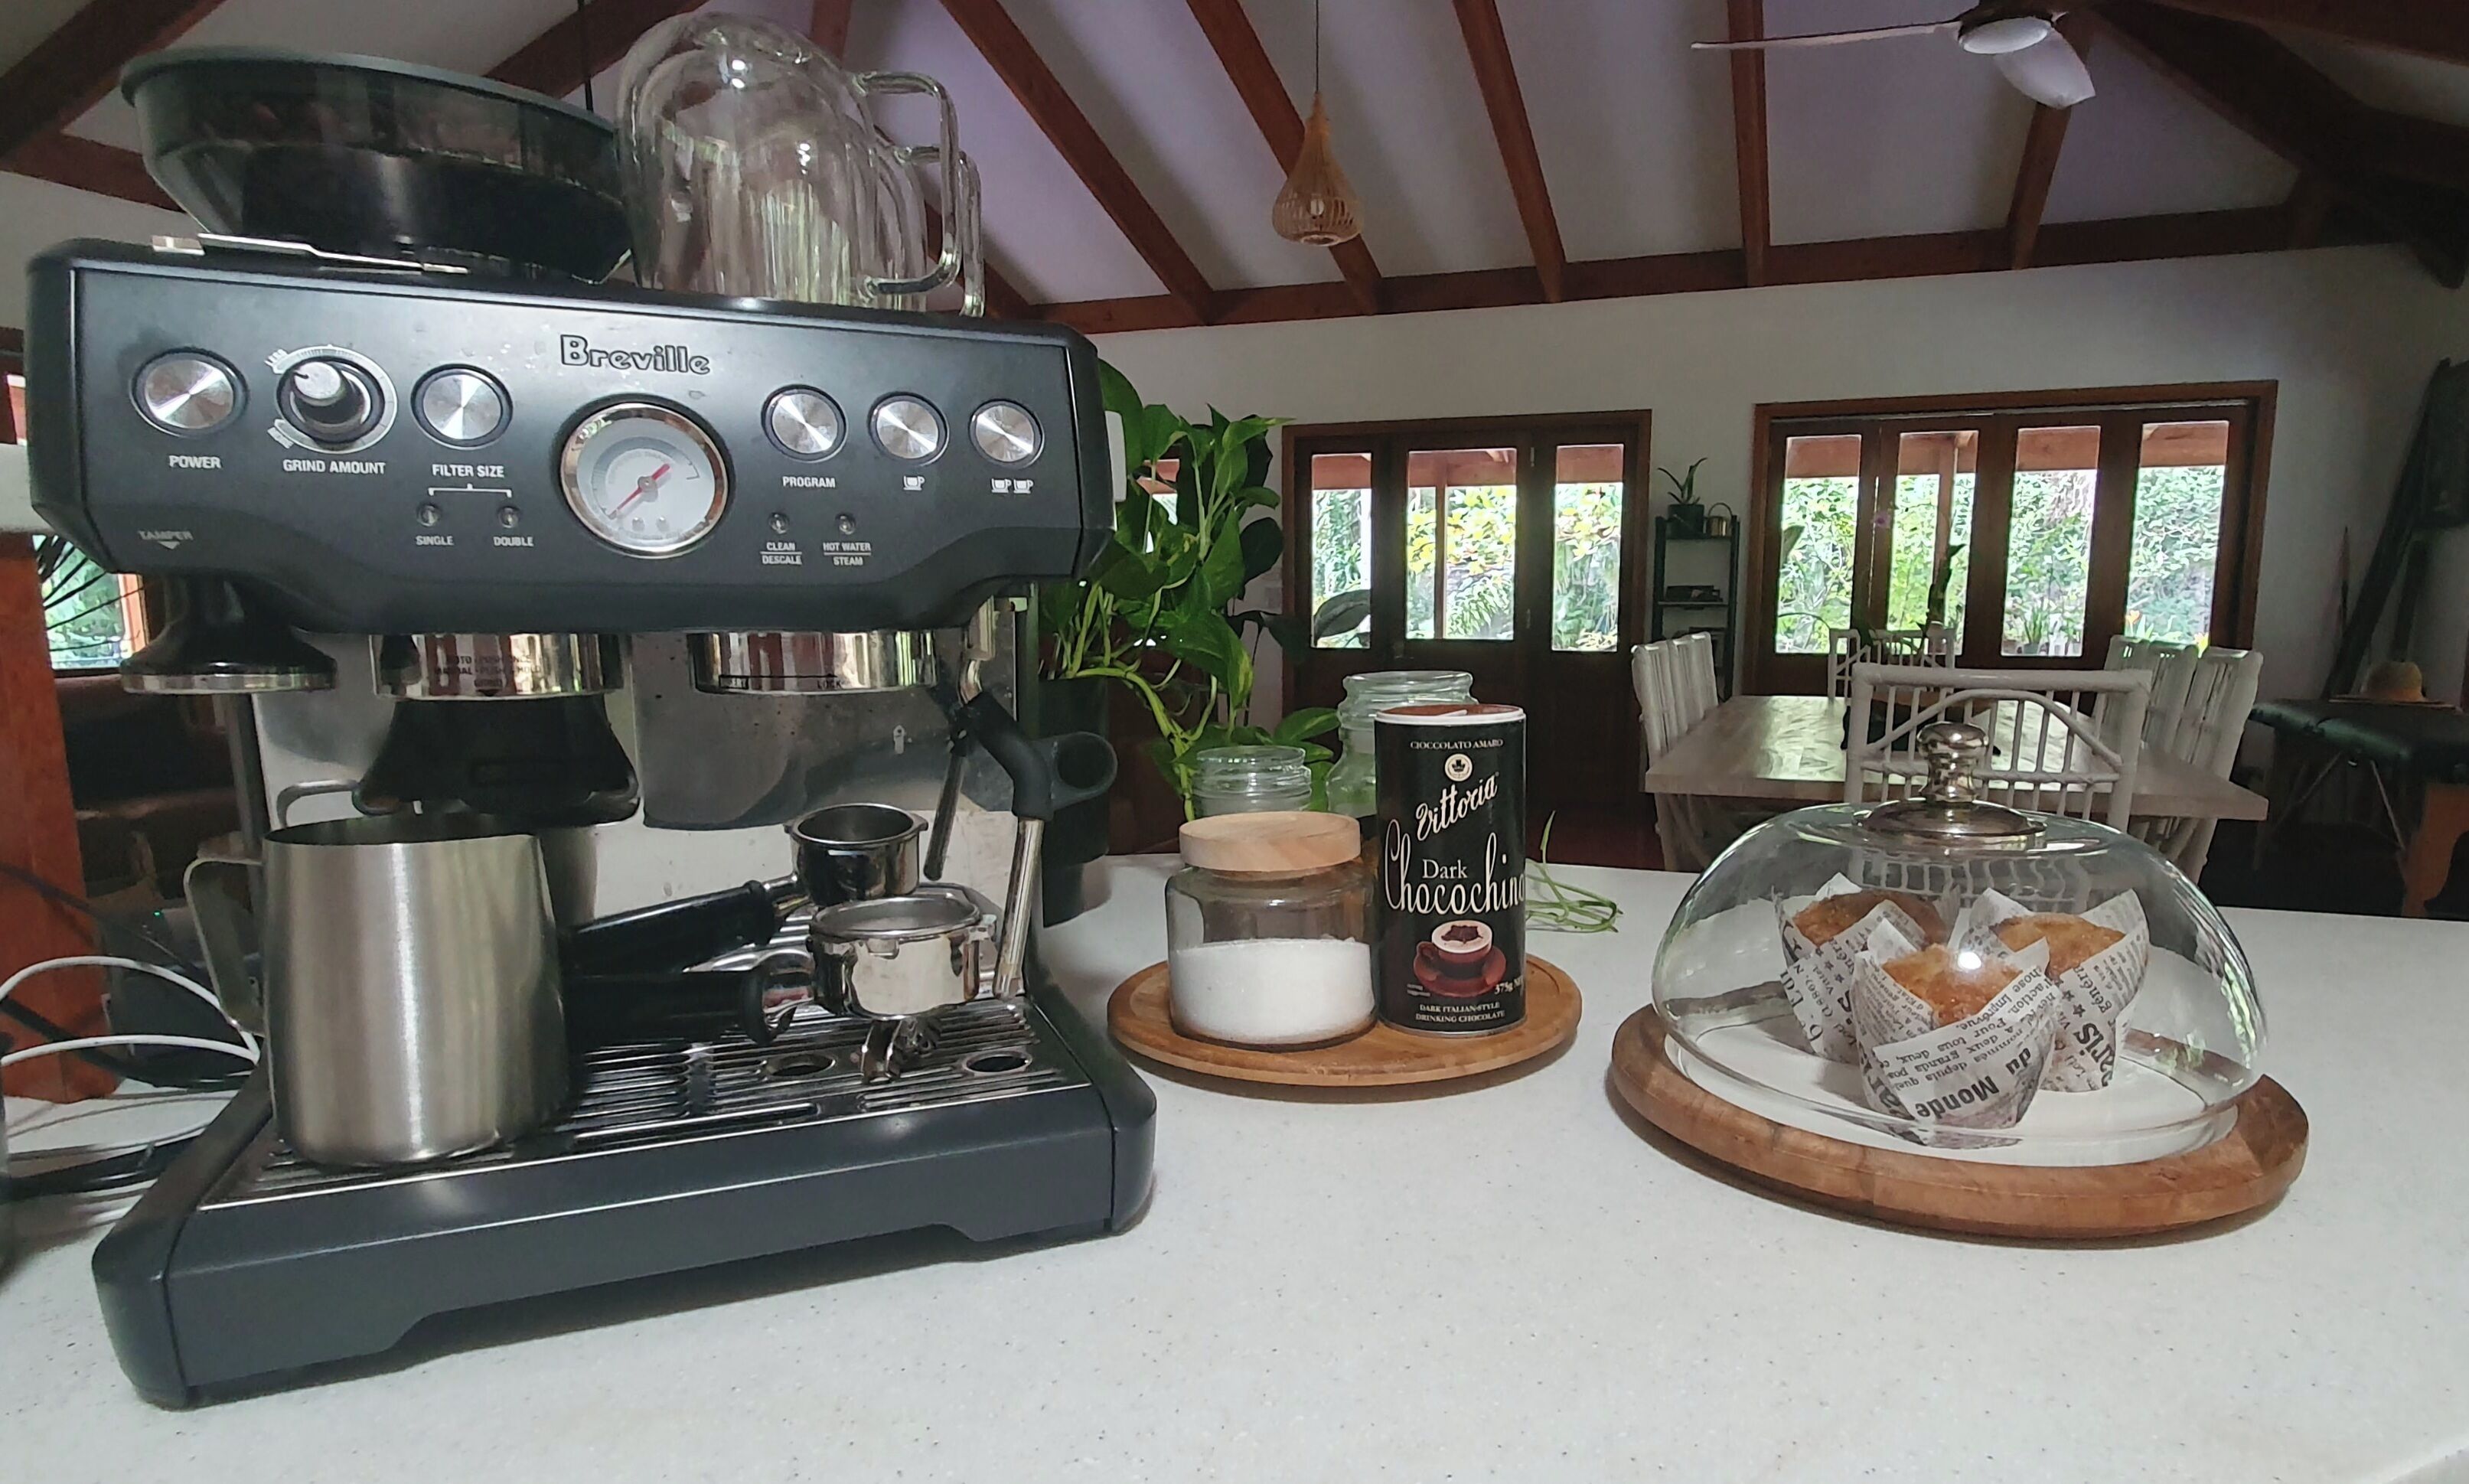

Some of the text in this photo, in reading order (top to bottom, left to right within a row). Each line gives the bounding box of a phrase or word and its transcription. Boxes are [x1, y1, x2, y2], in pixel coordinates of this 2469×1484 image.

[560, 334, 710, 374] Breville
[168, 455, 221, 468] POWER
[282, 459, 386, 474] GRIND AMOUNT
[432, 464, 504, 478] FILTER SIZE
[782, 476, 836, 488] PROGRAM
[138, 530, 194, 540] TAMPER
[416, 536, 454, 546] SINGLE
[493, 537, 534, 546] DOUBLE
[766, 542, 796, 551] CLEAN
[823, 542, 872, 551] HOT WATER
[762, 555, 802, 565] DESCALE
[833, 556, 863, 566] STEAM
[1410, 739, 1504, 750] CIOCCOLATO AMARO
[1415, 775, 1499, 842] Vittoria
[1385, 818, 1526, 915] Chocochino
[1423, 859, 1468, 879] Dark
[1420, 1002, 1500, 1013] DARK ITALIAN-STYLE
[1416, 1010, 1505, 1023] DRINKING CHOCOLATE
[1974, 1016, 2007, 1039] Pour
[1937, 1036, 1967, 1052] tous
[1966, 1033, 1999, 1054] deux
[2005, 1047, 2031, 1075] du
[1915, 1075, 2000, 1120] Monde
